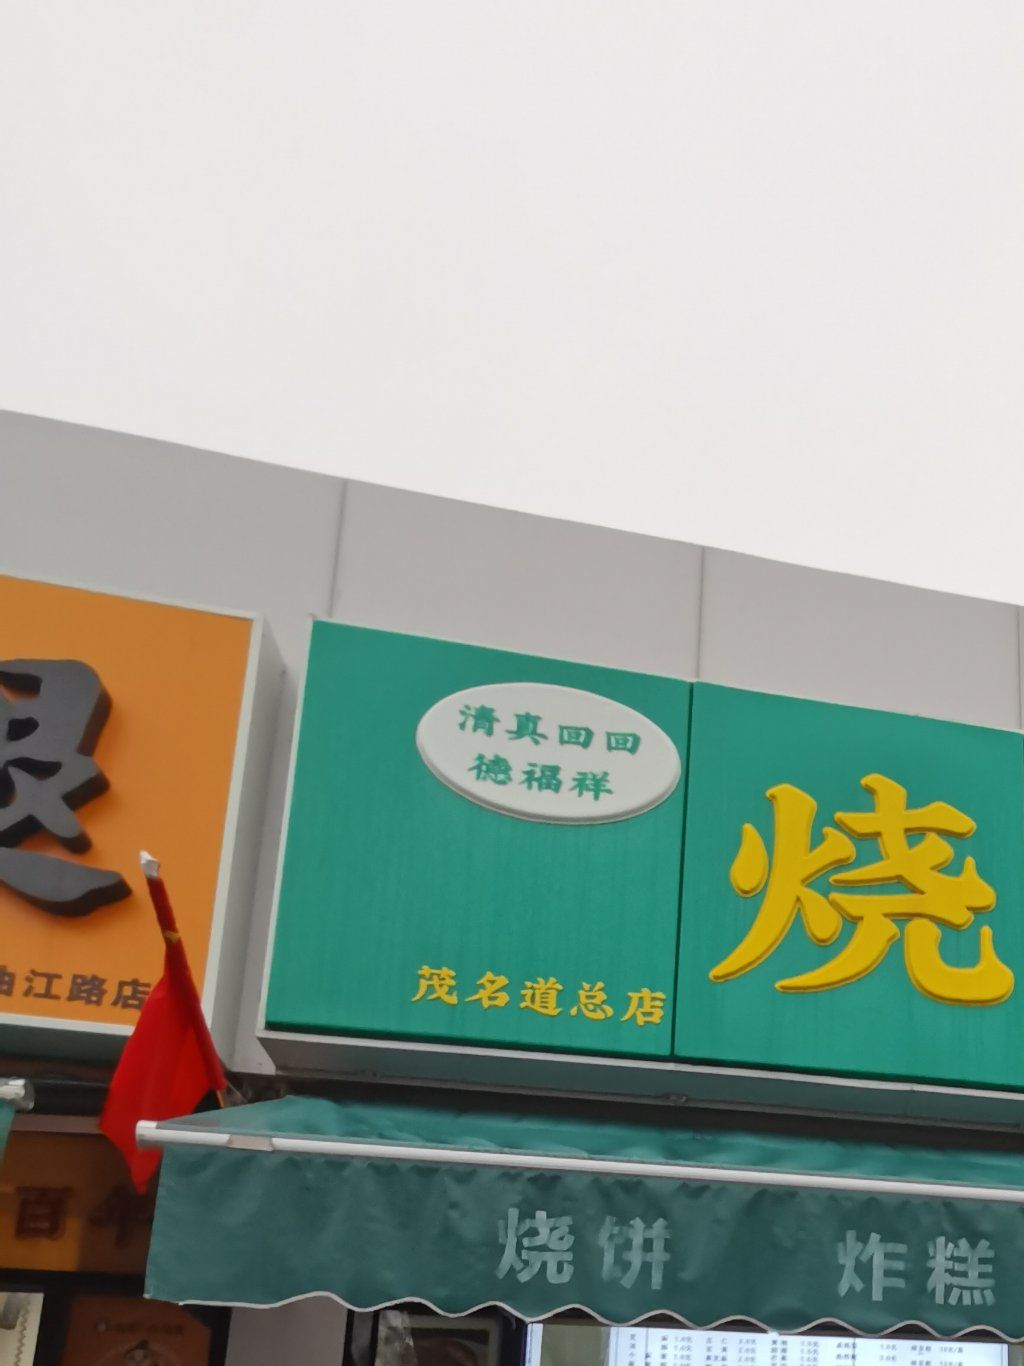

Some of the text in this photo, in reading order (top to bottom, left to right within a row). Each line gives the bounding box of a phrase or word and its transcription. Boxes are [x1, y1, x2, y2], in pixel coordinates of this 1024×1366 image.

[457, 704, 642, 756] 清真回回
[467, 752, 615, 801] 德福祥
[411, 965, 669, 1027] 茂名道总店
[497, 1207, 670, 1291] 烧饼
[836, 1229, 996, 1308] 炸糕
